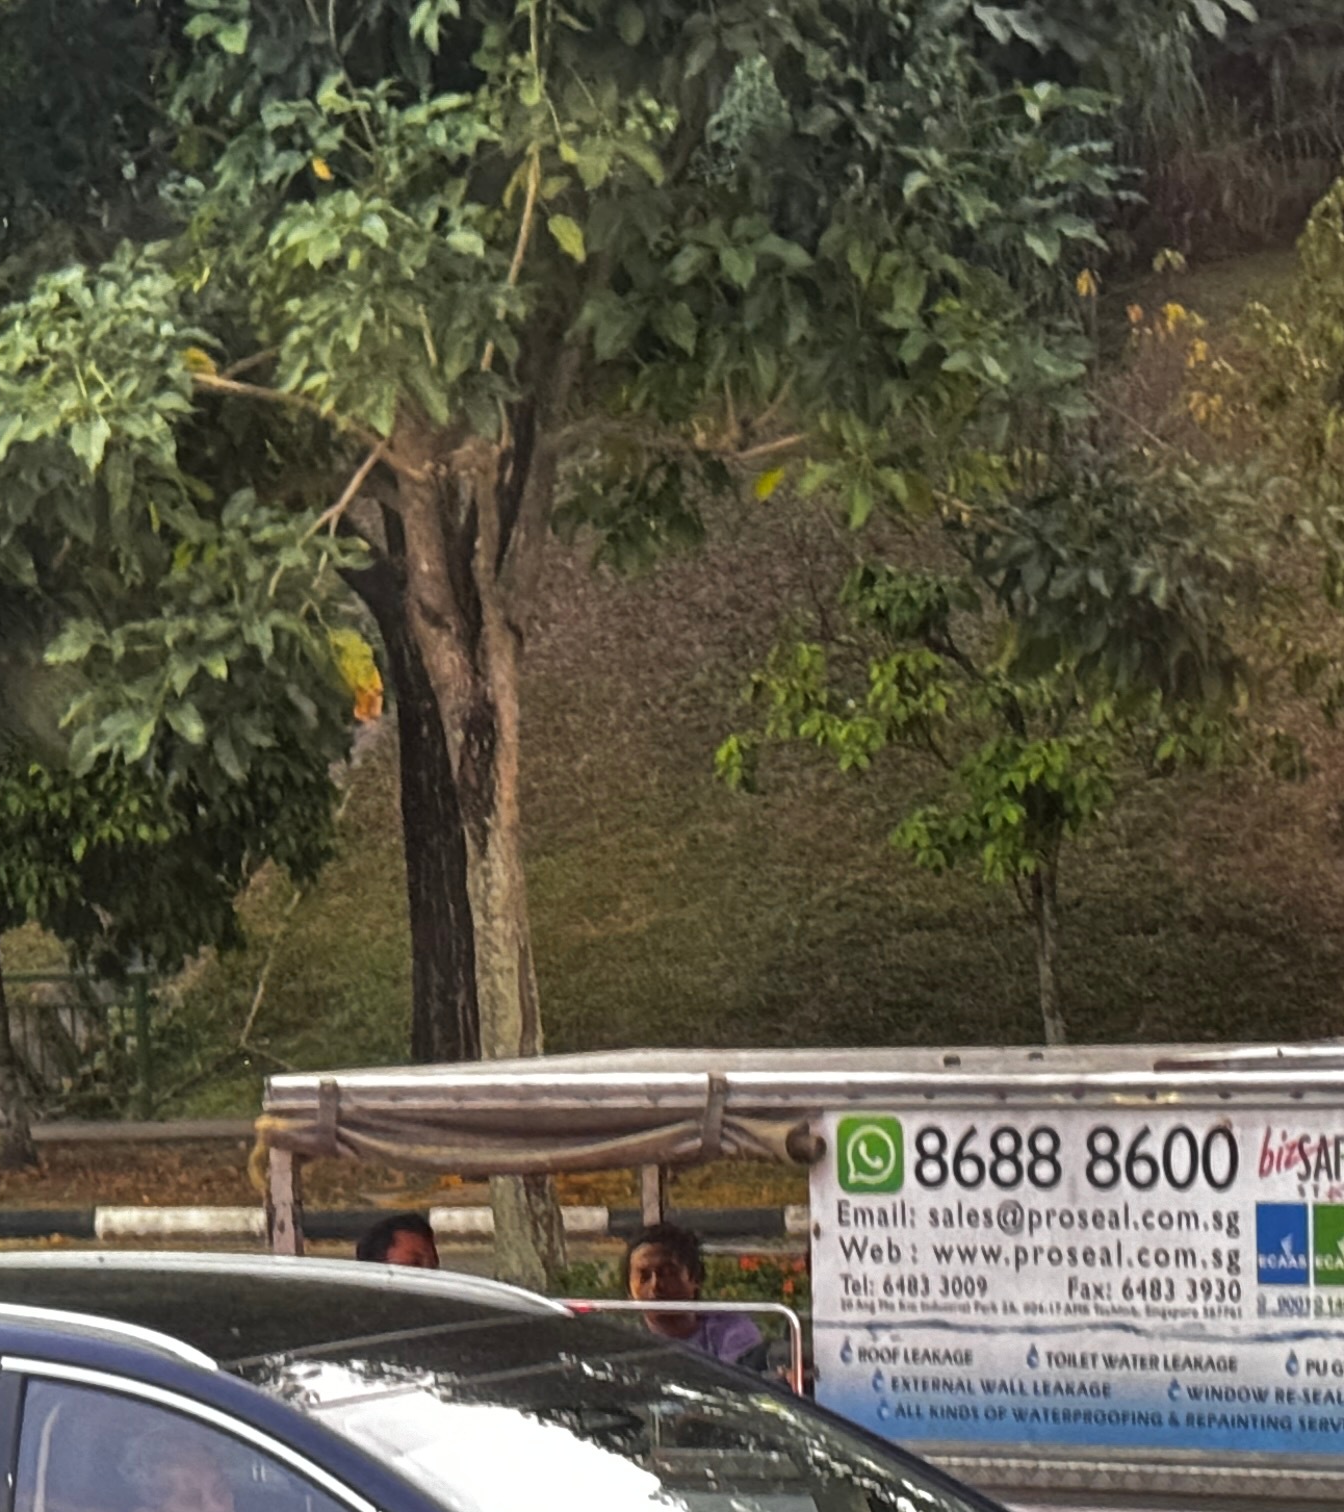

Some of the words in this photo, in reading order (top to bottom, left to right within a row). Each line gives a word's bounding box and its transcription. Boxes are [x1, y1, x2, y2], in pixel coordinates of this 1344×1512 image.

[914, 1124, 1063, 1189] 8688
[1086, 1124, 1240, 1192] 8600
[837, 1200, 916, 1228] Email:
[928, 1200, 1241, 1239] sales@proseal.com.sg
[932, 1238, 1241, 1276] www.proseal.com.sg
[840, 1273, 875, 1297] Tel:
[882, 1273, 930, 1298] 6483
[939, 1275, 988, 1298] 3009
[1068, 1275, 1112, 1301] Fax:
[1121, 1276, 1175, 1302] 6483
[1186, 1277, 1242, 1303] 3930
[858, 1346, 900, 1365] ROOF
[905, 1347, 974, 1367] LEAKAGE
[1046, 1350, 1097, 1370] TOILET
[1102, 1351, 1160, 1371] WATER
[1163, 1353, 1238, 1373] LEAKAGE
[1306, 1357, 1328, 1377] PU
[891, 1375, 975, 1395] EXTERNAL
[980, 1378, 1027, 1396] WALL
[1033, 1379, 1111, 1399] LEAKAGE
[1186, 1385, 1269, 1404] WINDOW
[895, 1402, 924, 1420] ALL
[929, 1403, 979, 1421] KINDS
[984, 1404, 1007, 1421] OF
[1012, 1406, 1164, 1428] WATERPROOFING
[1168, 1410, 1180, 1429] &
[1185, 1411, 1293, 1432] REPAINTING
